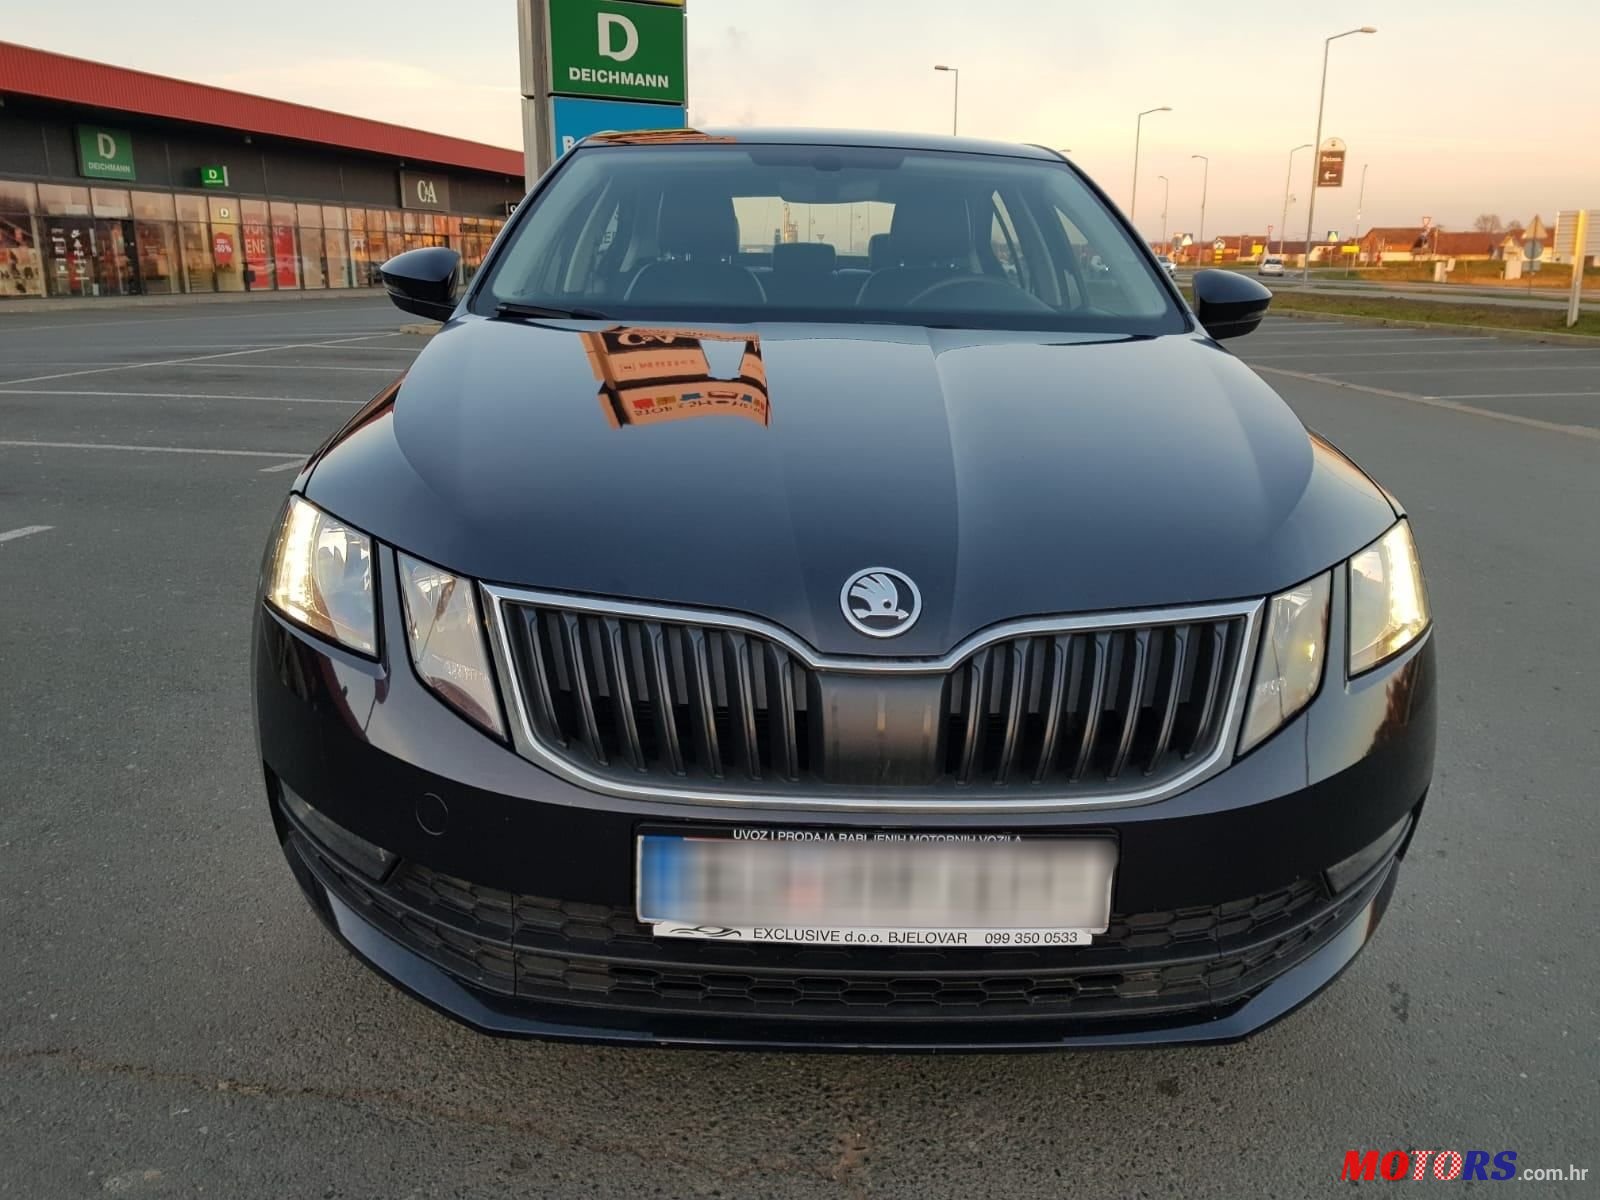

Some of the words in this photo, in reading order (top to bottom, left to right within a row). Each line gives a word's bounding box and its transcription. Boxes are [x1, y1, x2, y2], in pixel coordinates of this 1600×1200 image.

[597, 12, 639, 62] D
[568, 66, 669, 88] DEICHMANN
[97, 133, 116, 159] D
[88, 161, 131, 173] DEICHMANN
[417, 179, 438, 204] C&A
[733, 829, 768, 841] UVOZ
[778, 831, 836, 841] PRODAJA
[753, 927, 840, 942] EXCLUSIVE
[844, 931, 883, 943] d.o.o.
[888, 931, 968, 944] BJELOVAR
[984, 932, 1010, 944] 099
[1014, 932, 1040, 944] 350
[1044, 932, 1077, 943] 0533
